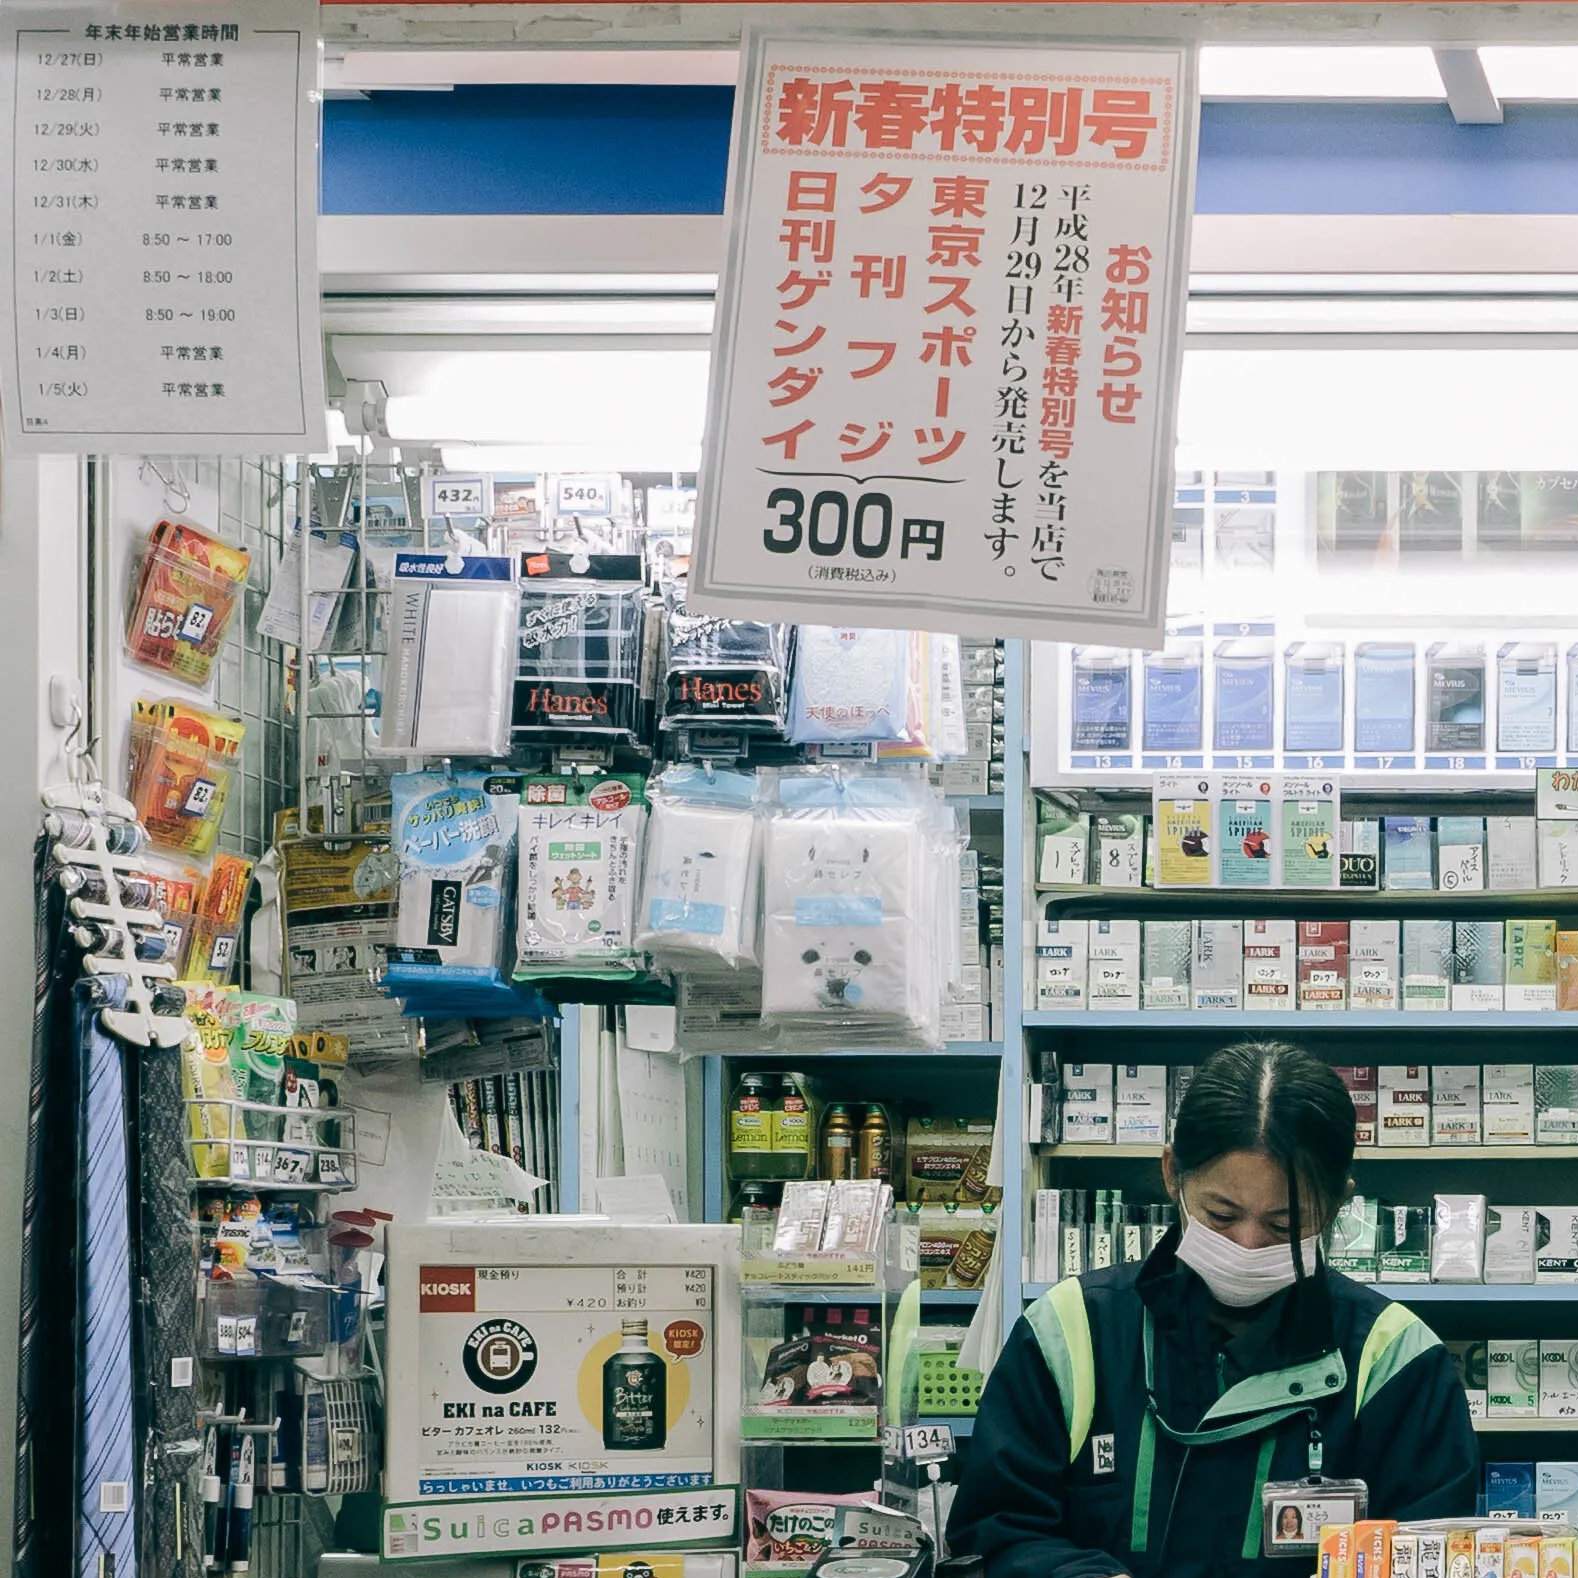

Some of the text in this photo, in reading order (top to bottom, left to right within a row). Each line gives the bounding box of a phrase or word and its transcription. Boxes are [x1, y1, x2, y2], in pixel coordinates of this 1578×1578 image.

[85, 24, 239, 42] 年末年始営業時間
[38, 53, 223, 67] 12/27(日) 平常営業
[37, 87, 221, 102] 12/28(月) 平常営業
[775, 78, 1159, 159] 新春特別号
[34, 123, 220, 137] 12/29(火) 平常営業
[33, 158, 218, 173] 12/30(水) 平常営業
[33, 195, 218, 210] 12/31(木) 平常営業
[34, 232, 232, 246] 1/1(金) 8:50 17:00
[34, 269, 233, 284] 1/2(土) 8:50 18:00
[35, 308, 235, 322] 1/3(日) 8:50 19:00
[762, 172, 838, 459] 日刊ゲンダイ
[838, 172, 913, 464] 夕刊フジ
[913, 175, 990, 465] 東京スポーツ
[1097, 242, 1154, 425] お知らせ
[36, 346, 223, 360] 1/4(月) 平常営業
[38, 383, 225, 397] 1/5(火) 平常営業
[762, 488, 945, 560] 300円
[808, 563, 896, 584] (消費税込み)
[401, 592, 420, 646] WHITE
[681, 677, 762, 704] Hanes
[530, 688, 608, 716] Hanes
[1095, 757, 1111, 769] 13
[1165, 757, 1182, 769] 14
[1236, 757, 1252, 769] 15
[1307, 757, 1324, 769] 16
[1377, 757, 1394, 769] 17
[1448, 757, 1464, 769] 18
[1519, 757, 1536, 769] 19
[528, 784, 566, 803] 除菌
[532, 813, 622, 829] キレイキレイ
[440, 886, 457, 944] GATSBY
[1042, 948, 1068, 957] LARK
[1093, 948, 1117, 957] LARK
[1250, 948, 1276, 957] LARK
[1304, 949, 1325, 958] LARK
[1537, 1258, 1568, 1268] KENT
[421, 1283, 471, 1295] KIOSK
[616, 1284, 647, 1294] 預り計
[443, 1401, 556, 1419] EKI na CAFE
[423, 1503, 729, 1542] Suica PASMO 使えます。
